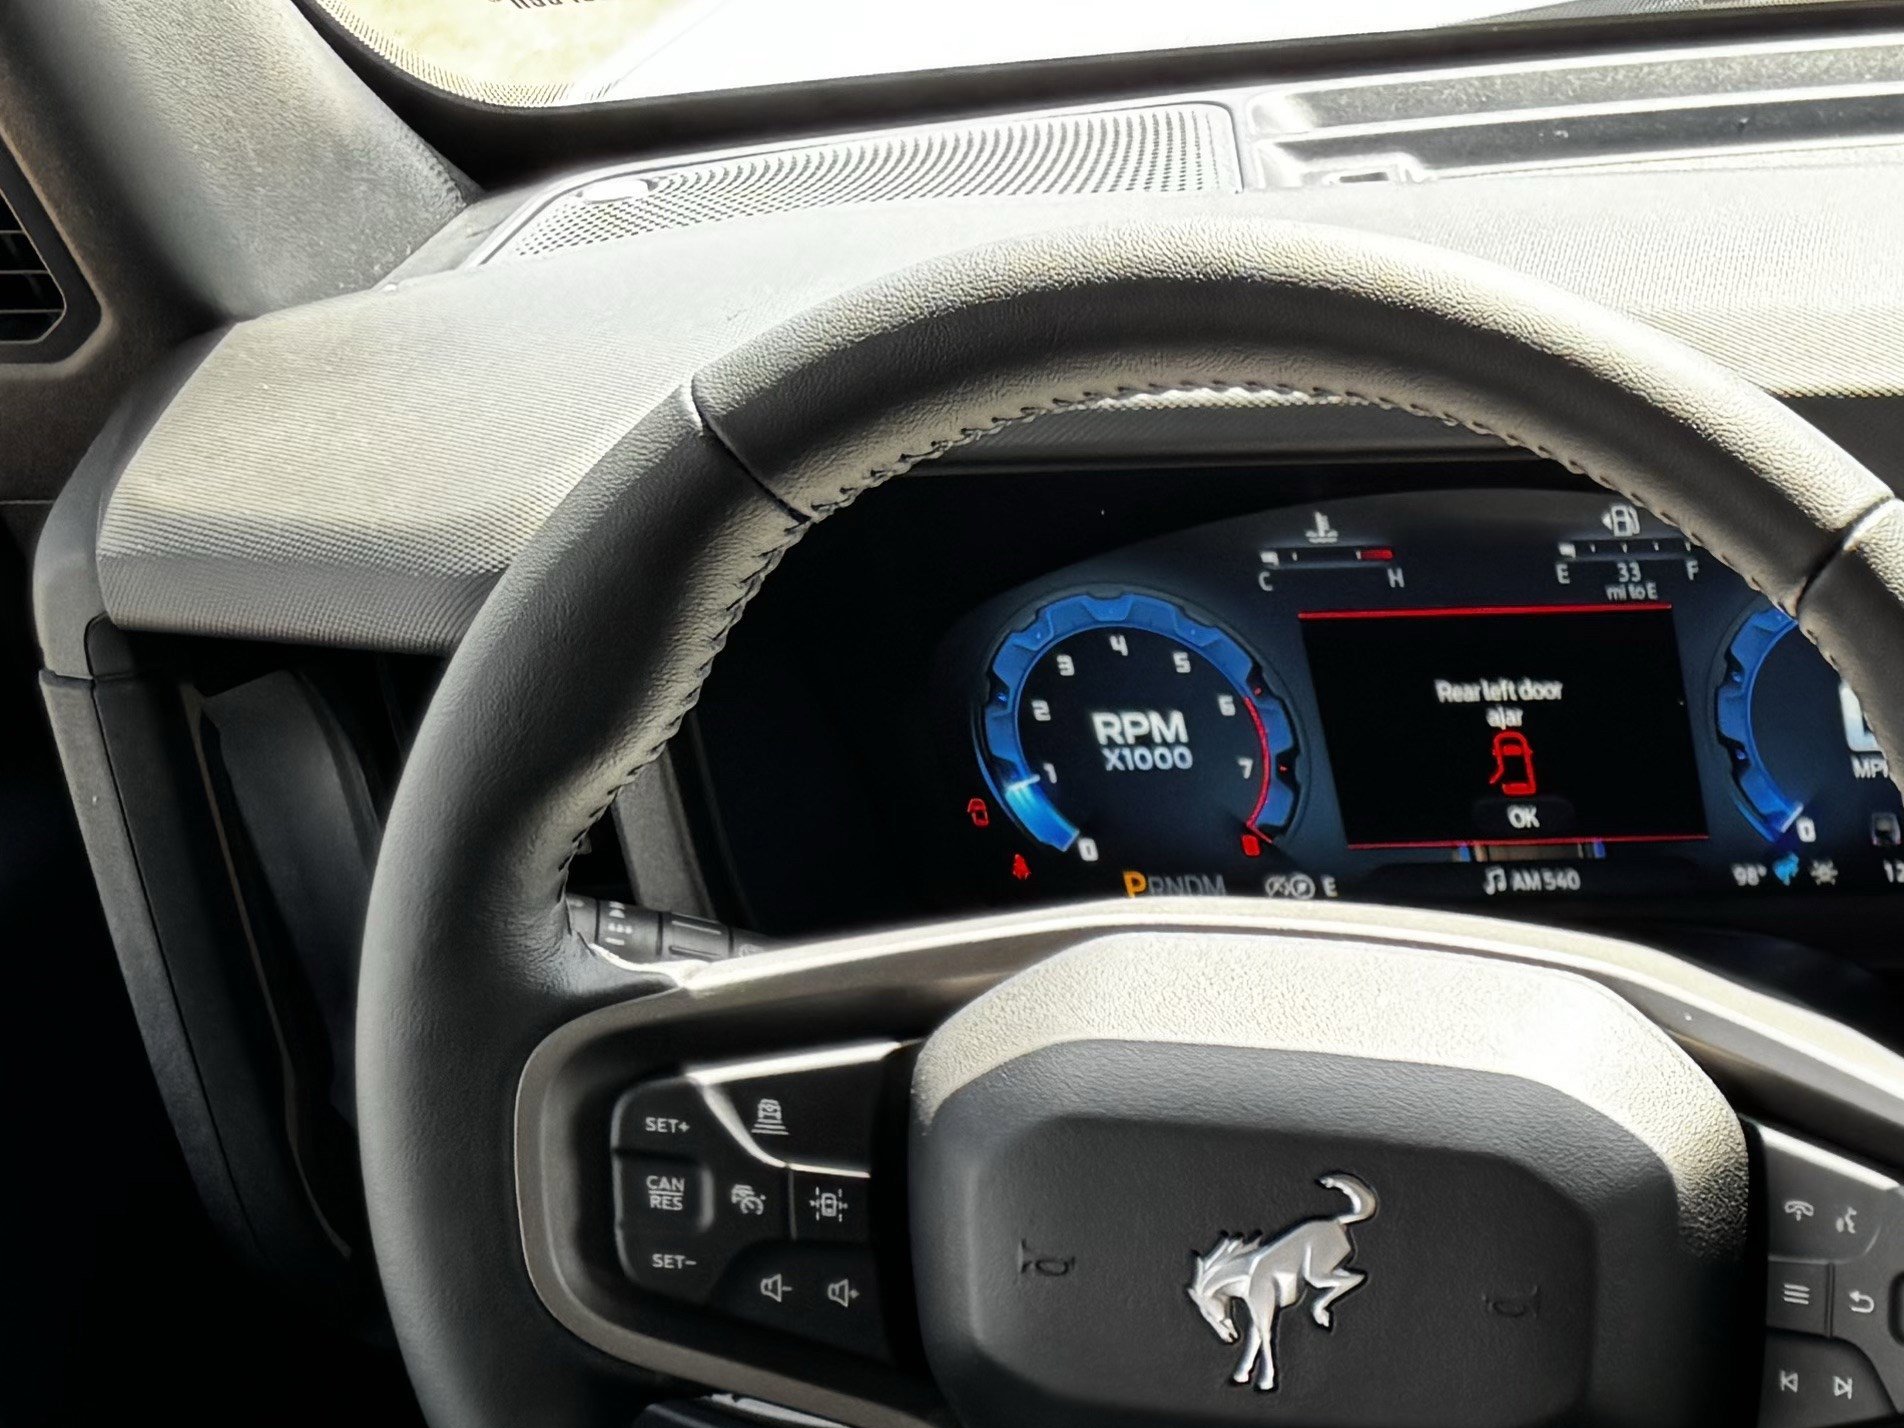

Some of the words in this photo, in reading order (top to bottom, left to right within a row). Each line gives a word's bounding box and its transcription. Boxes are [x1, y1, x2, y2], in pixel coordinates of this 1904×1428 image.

[1259, 571, 1274, 591] C
[1387, 569, 1405, 589] H
[1556, 563, 1571, 584] E
[1617, 562, 1641, 583] 33
[1686, 560, 1699, 581] F
[1605, 584, 1627, 600] mi
[1628, 583, 1645, 600] to
[1646, 582, 1658, 600] E
[1110, 636, 1128, 656] 4
[1057, 655, 1074, 676] 3
[1174, 652, 1190, 673] 5
[1434, 679, 1481, 702] Rear
[1480, 677, 1518, 701] left
[1518, 677, 1563, 700] door
[1033, 700, 1051, 721] 2
[1219, 695, 1235, 715] 6
[1092, 710, 1188, 745] RPM
[1486, 704, 1523, 730] ajar
[1104, 746, 1193, 771] X1000
[1239, 759, 1252, 779] 7
[1044, 764, 1057, 784] 1
[1507, 805, 1540, 828] OK
[1796, 817, 1816, 842] 0
[1077, 837, 1098, 861] 0
[1511, 869, 1542, 891] AM
[1542, 868, 1581, 891] 540
[646, 1176, 684, 1192] CAN
[649, 1195, 683, 1210] RES
